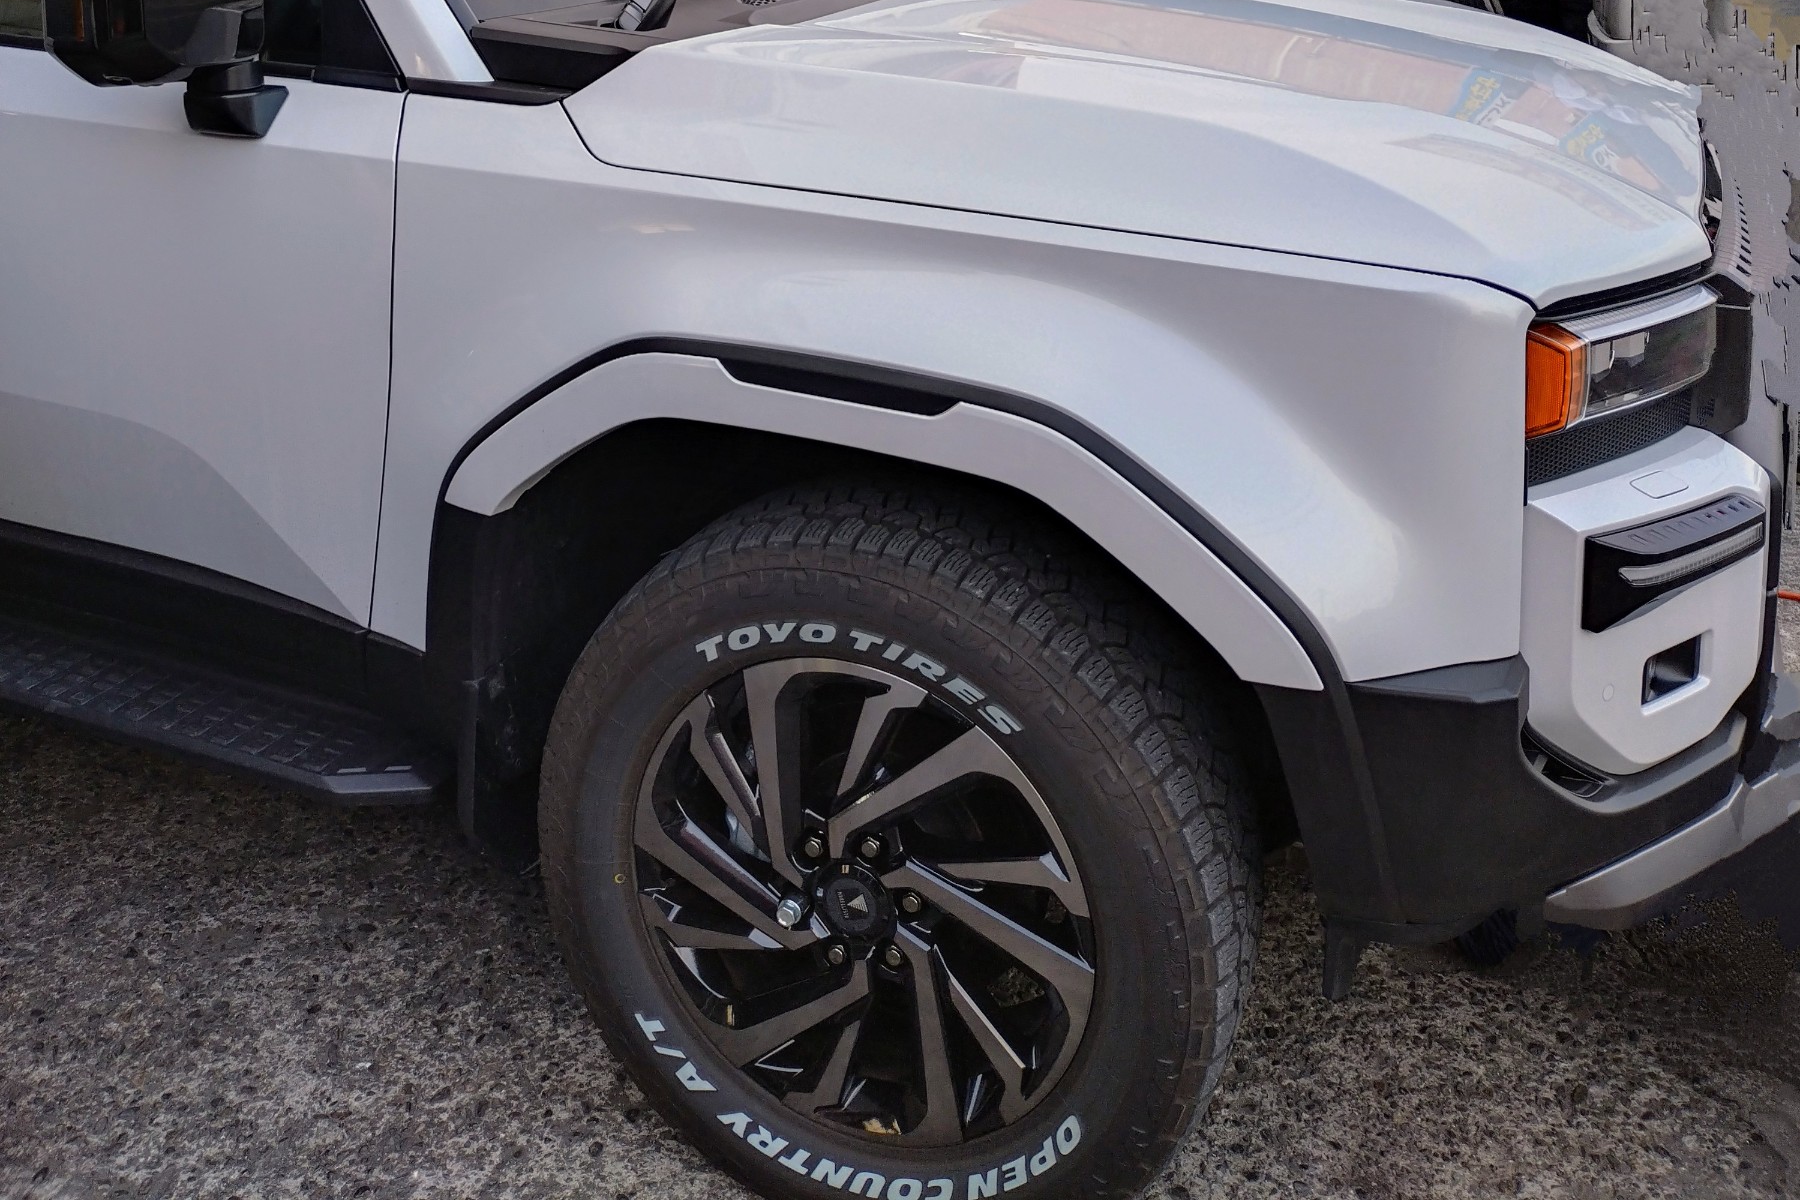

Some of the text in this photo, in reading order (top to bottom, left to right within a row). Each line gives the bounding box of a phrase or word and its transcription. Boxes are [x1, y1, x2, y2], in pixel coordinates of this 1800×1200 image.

[696, 622, 1025, 735] TOYO TIRES
[634, 1012, 1084, 1200] OPEN COUNTRY A/T
